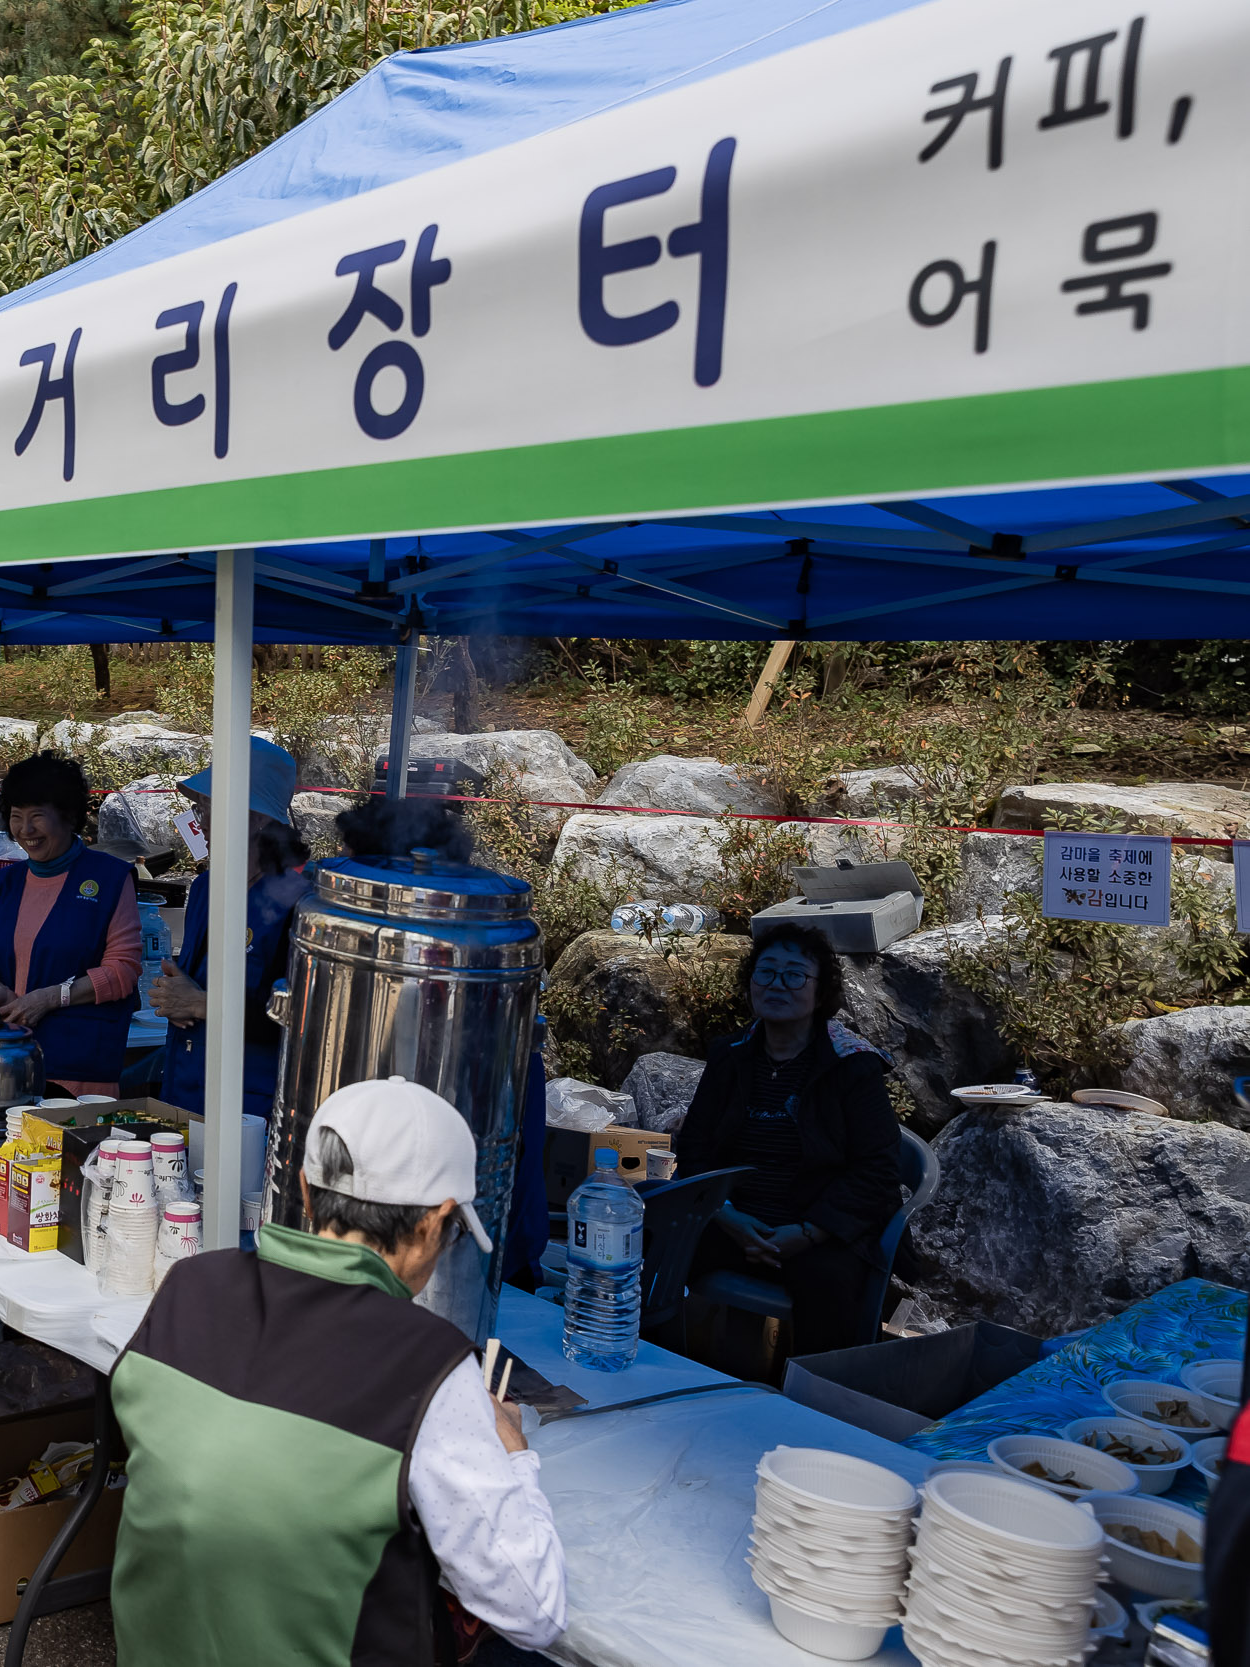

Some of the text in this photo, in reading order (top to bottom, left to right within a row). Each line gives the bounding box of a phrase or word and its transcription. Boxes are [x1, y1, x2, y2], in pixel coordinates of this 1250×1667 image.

[917, 15, 1194, 172] 커피,
[908, 210, 1173, 356] 어묵
[1060, 845, 1153, 866] 감마을 축제에
[1059, 866, 1153, 887] 사용할 소중한
[1087, 888, 1149, 910] 감입니다
